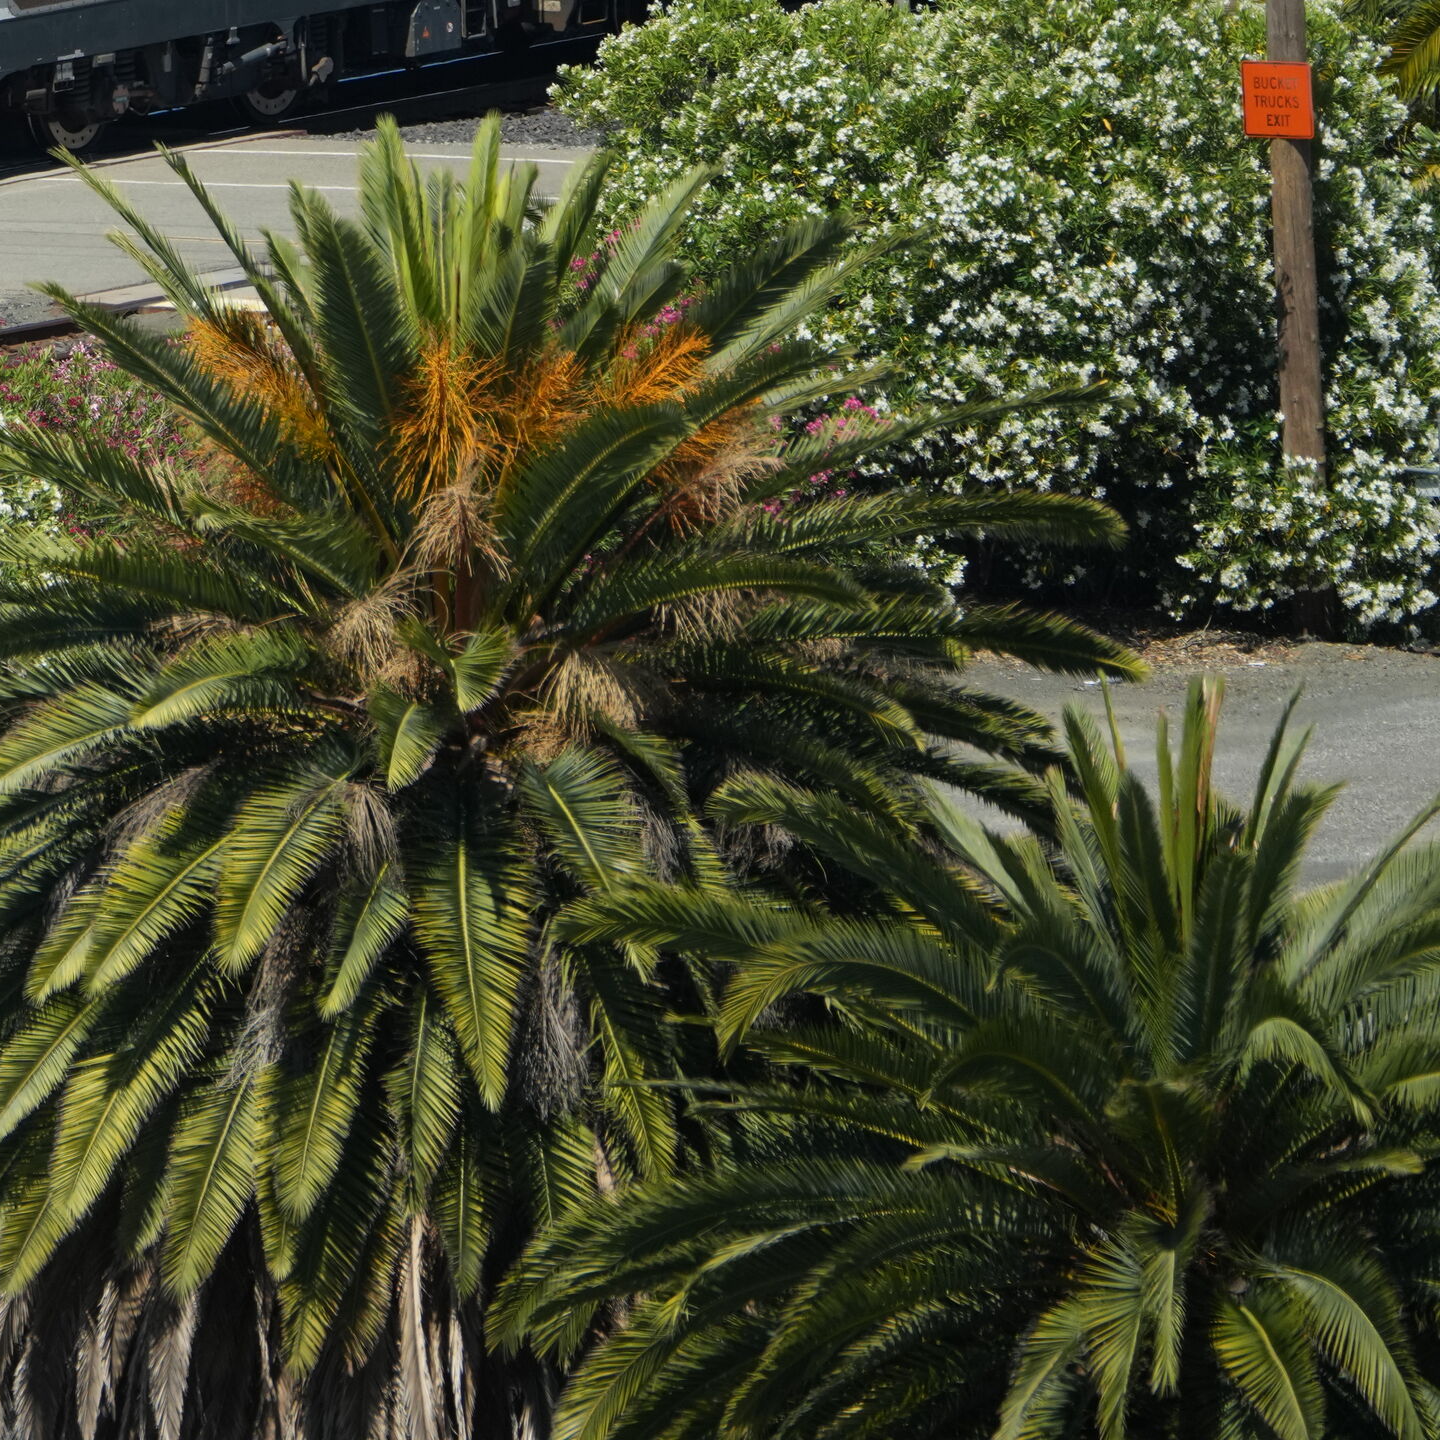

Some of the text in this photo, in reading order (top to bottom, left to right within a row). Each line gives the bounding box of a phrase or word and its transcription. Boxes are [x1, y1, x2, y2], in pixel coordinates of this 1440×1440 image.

[1253, 76, 1298, 90] BUCKET
[1253, 95, 1300, 109] TRUCKS
[1266, 114, 1292, 127] EXIT
